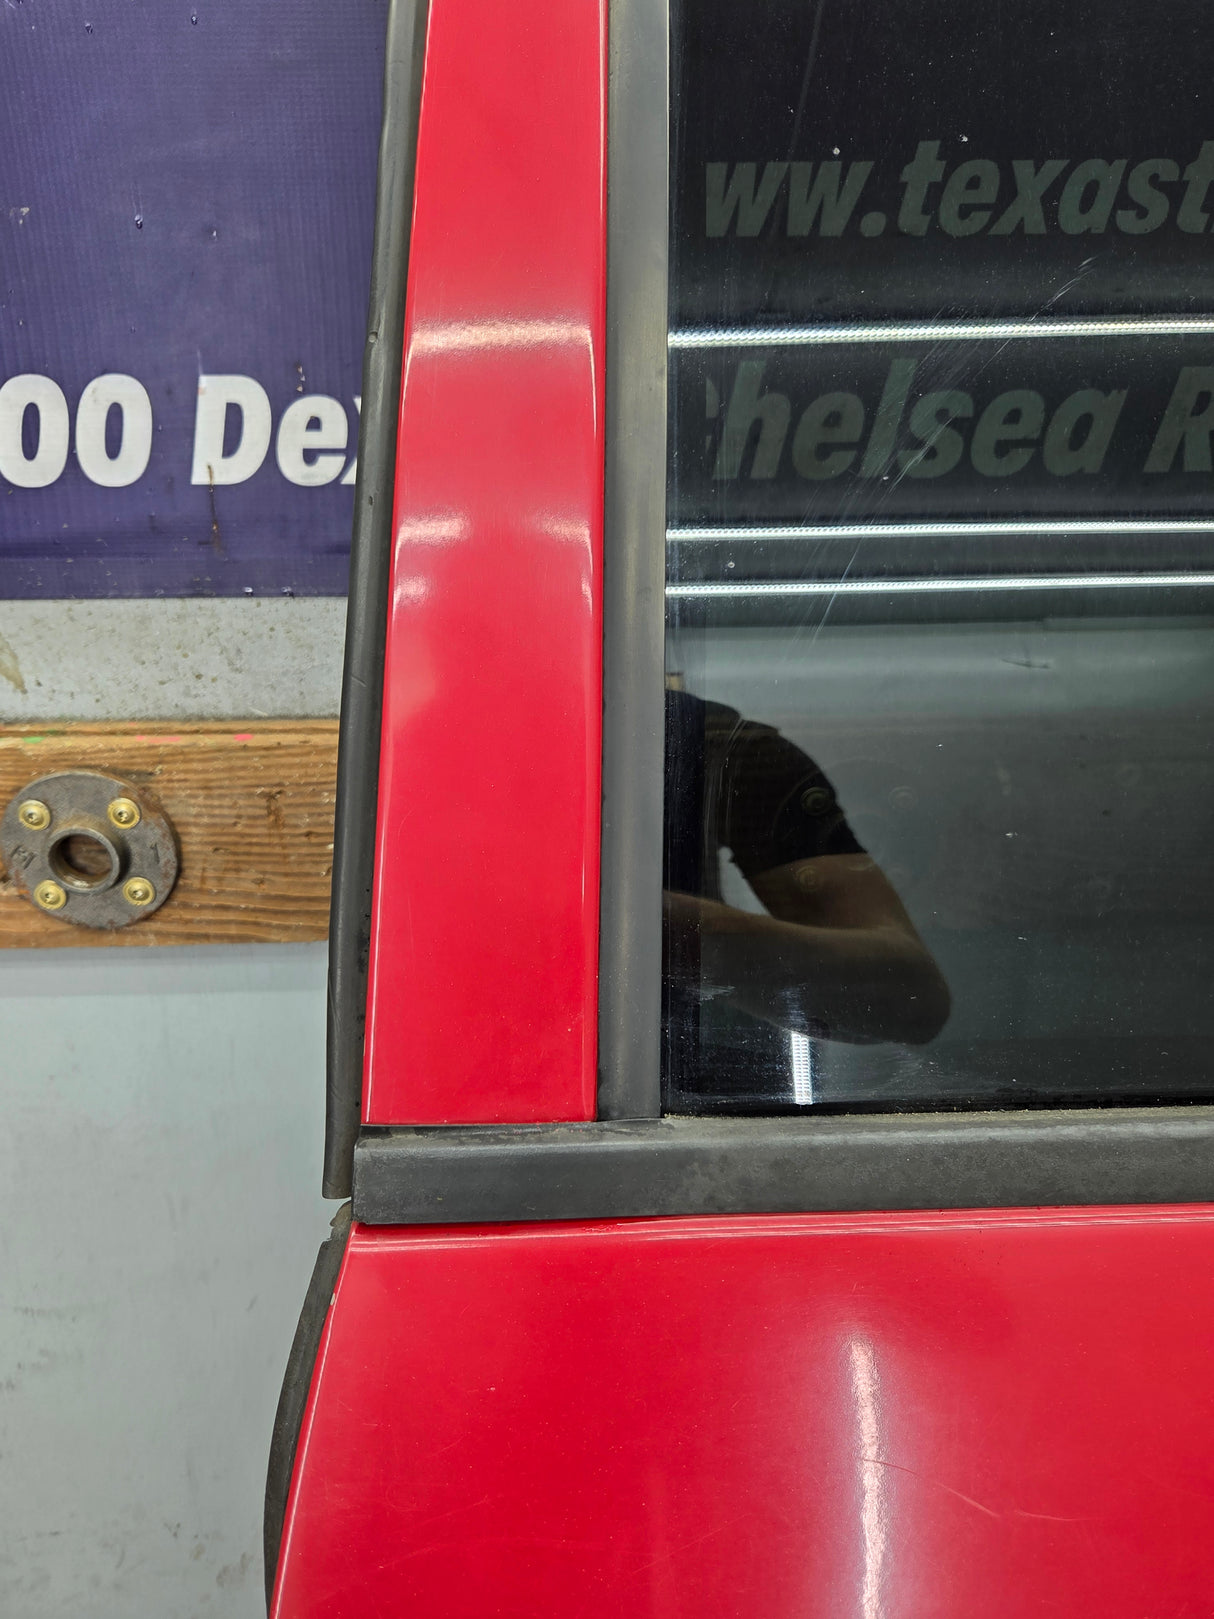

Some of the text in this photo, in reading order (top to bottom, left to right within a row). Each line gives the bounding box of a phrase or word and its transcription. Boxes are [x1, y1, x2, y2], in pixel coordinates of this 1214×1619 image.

[705, 139, 1214, 238] ww.texast
[190, 374, 361, 487] De
[705, 358, 1128, 481] helsea
